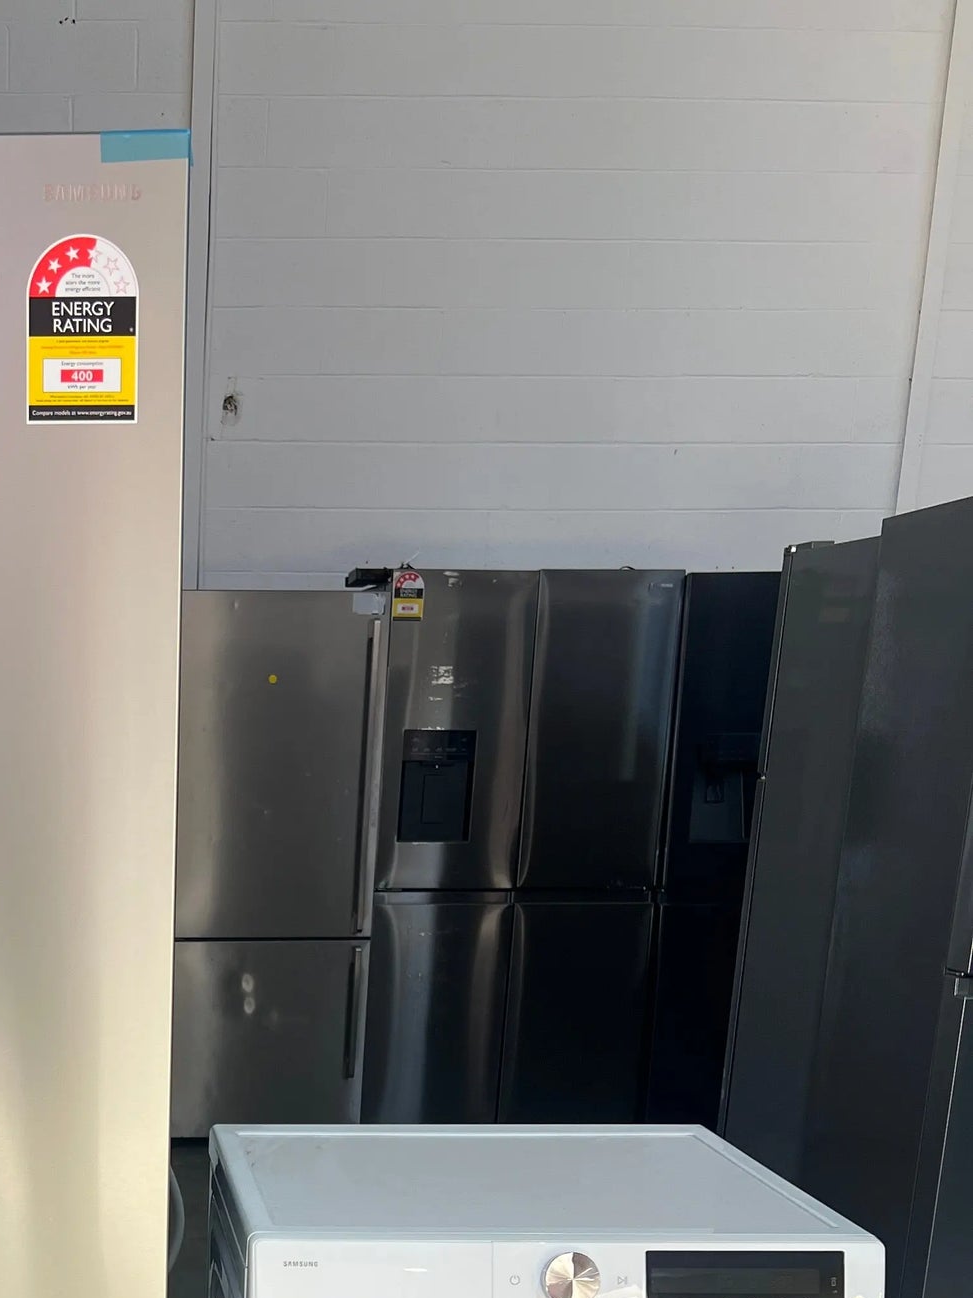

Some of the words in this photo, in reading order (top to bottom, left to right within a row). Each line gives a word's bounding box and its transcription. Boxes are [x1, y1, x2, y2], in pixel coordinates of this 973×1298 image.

[52, 301, 114, 316] ENERGY
[53, 318, 112, 333] RATING
[71, 370, 93, 381] 400
